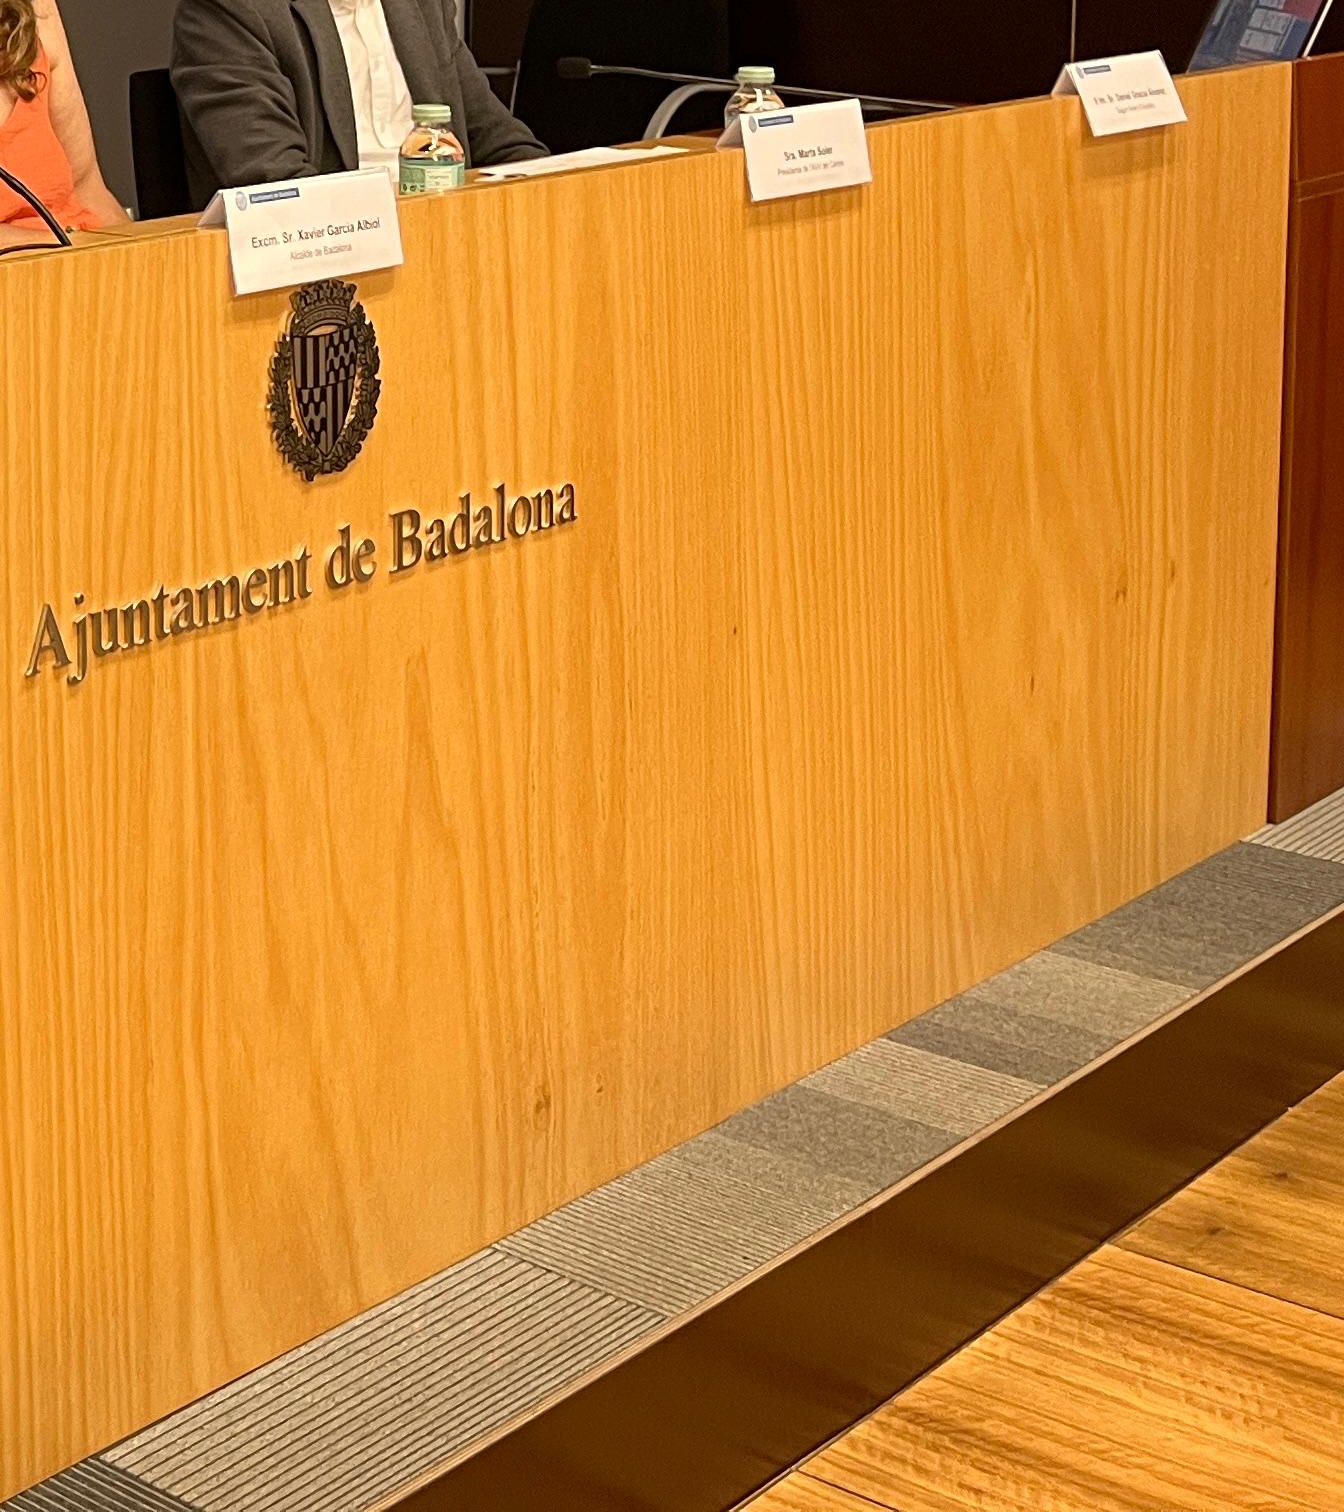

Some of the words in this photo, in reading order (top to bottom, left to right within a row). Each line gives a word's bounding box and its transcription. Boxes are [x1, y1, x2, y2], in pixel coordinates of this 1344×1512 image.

[252, 236, 280, 249] Excm.
[297, 227, 326, 241] Xavier
[25, 545, 312, 685] Ajuntament
[324, 524, 377, 590] de
[388, 482, 579, 575] Badalona
